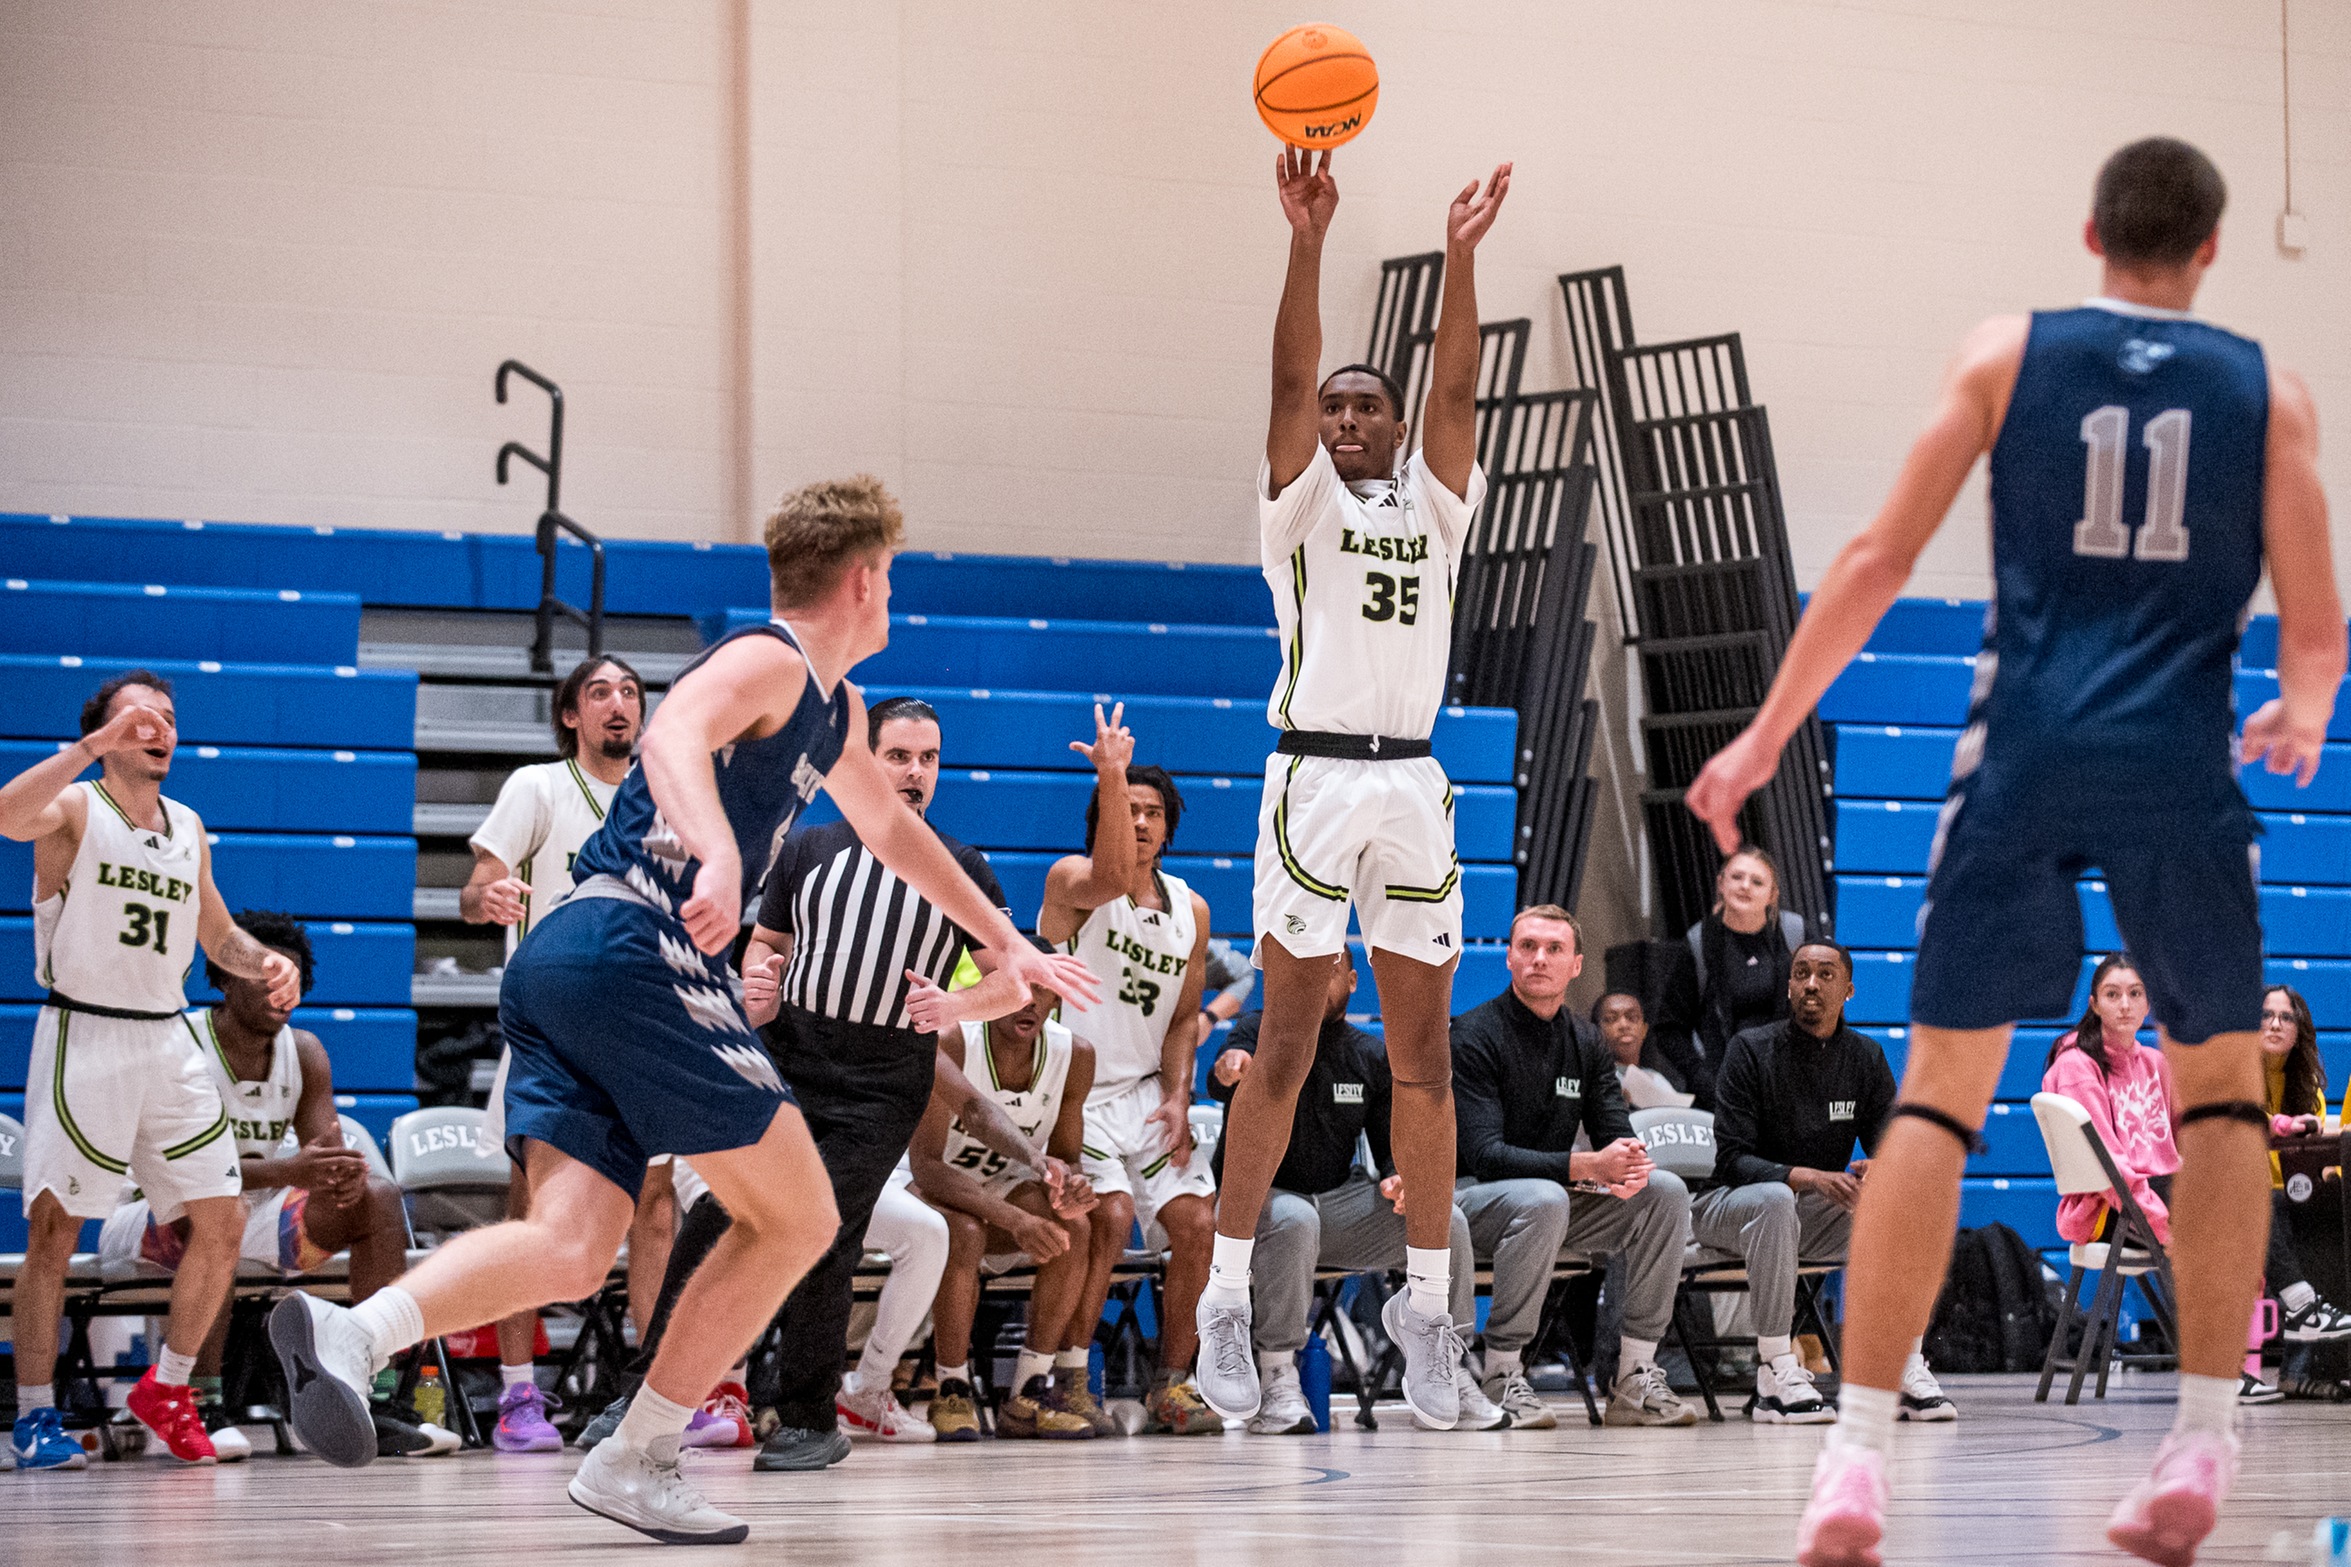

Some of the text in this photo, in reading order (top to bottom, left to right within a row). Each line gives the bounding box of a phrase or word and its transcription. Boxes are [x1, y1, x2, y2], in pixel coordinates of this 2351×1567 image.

[1304, 111, 1362, 139] NCAA
[2073, 404, 2192, 562] 11
[1361, 571, 1421, 626] 35
[97, 861, 193, 905] LESLEY
[118, 902, 170, 956] 31
[1118, 966, 1161, 1018] 33
[410, 1124, 484, 1157] LESL
[1636, 1122, 1714, 1151] LESLE
